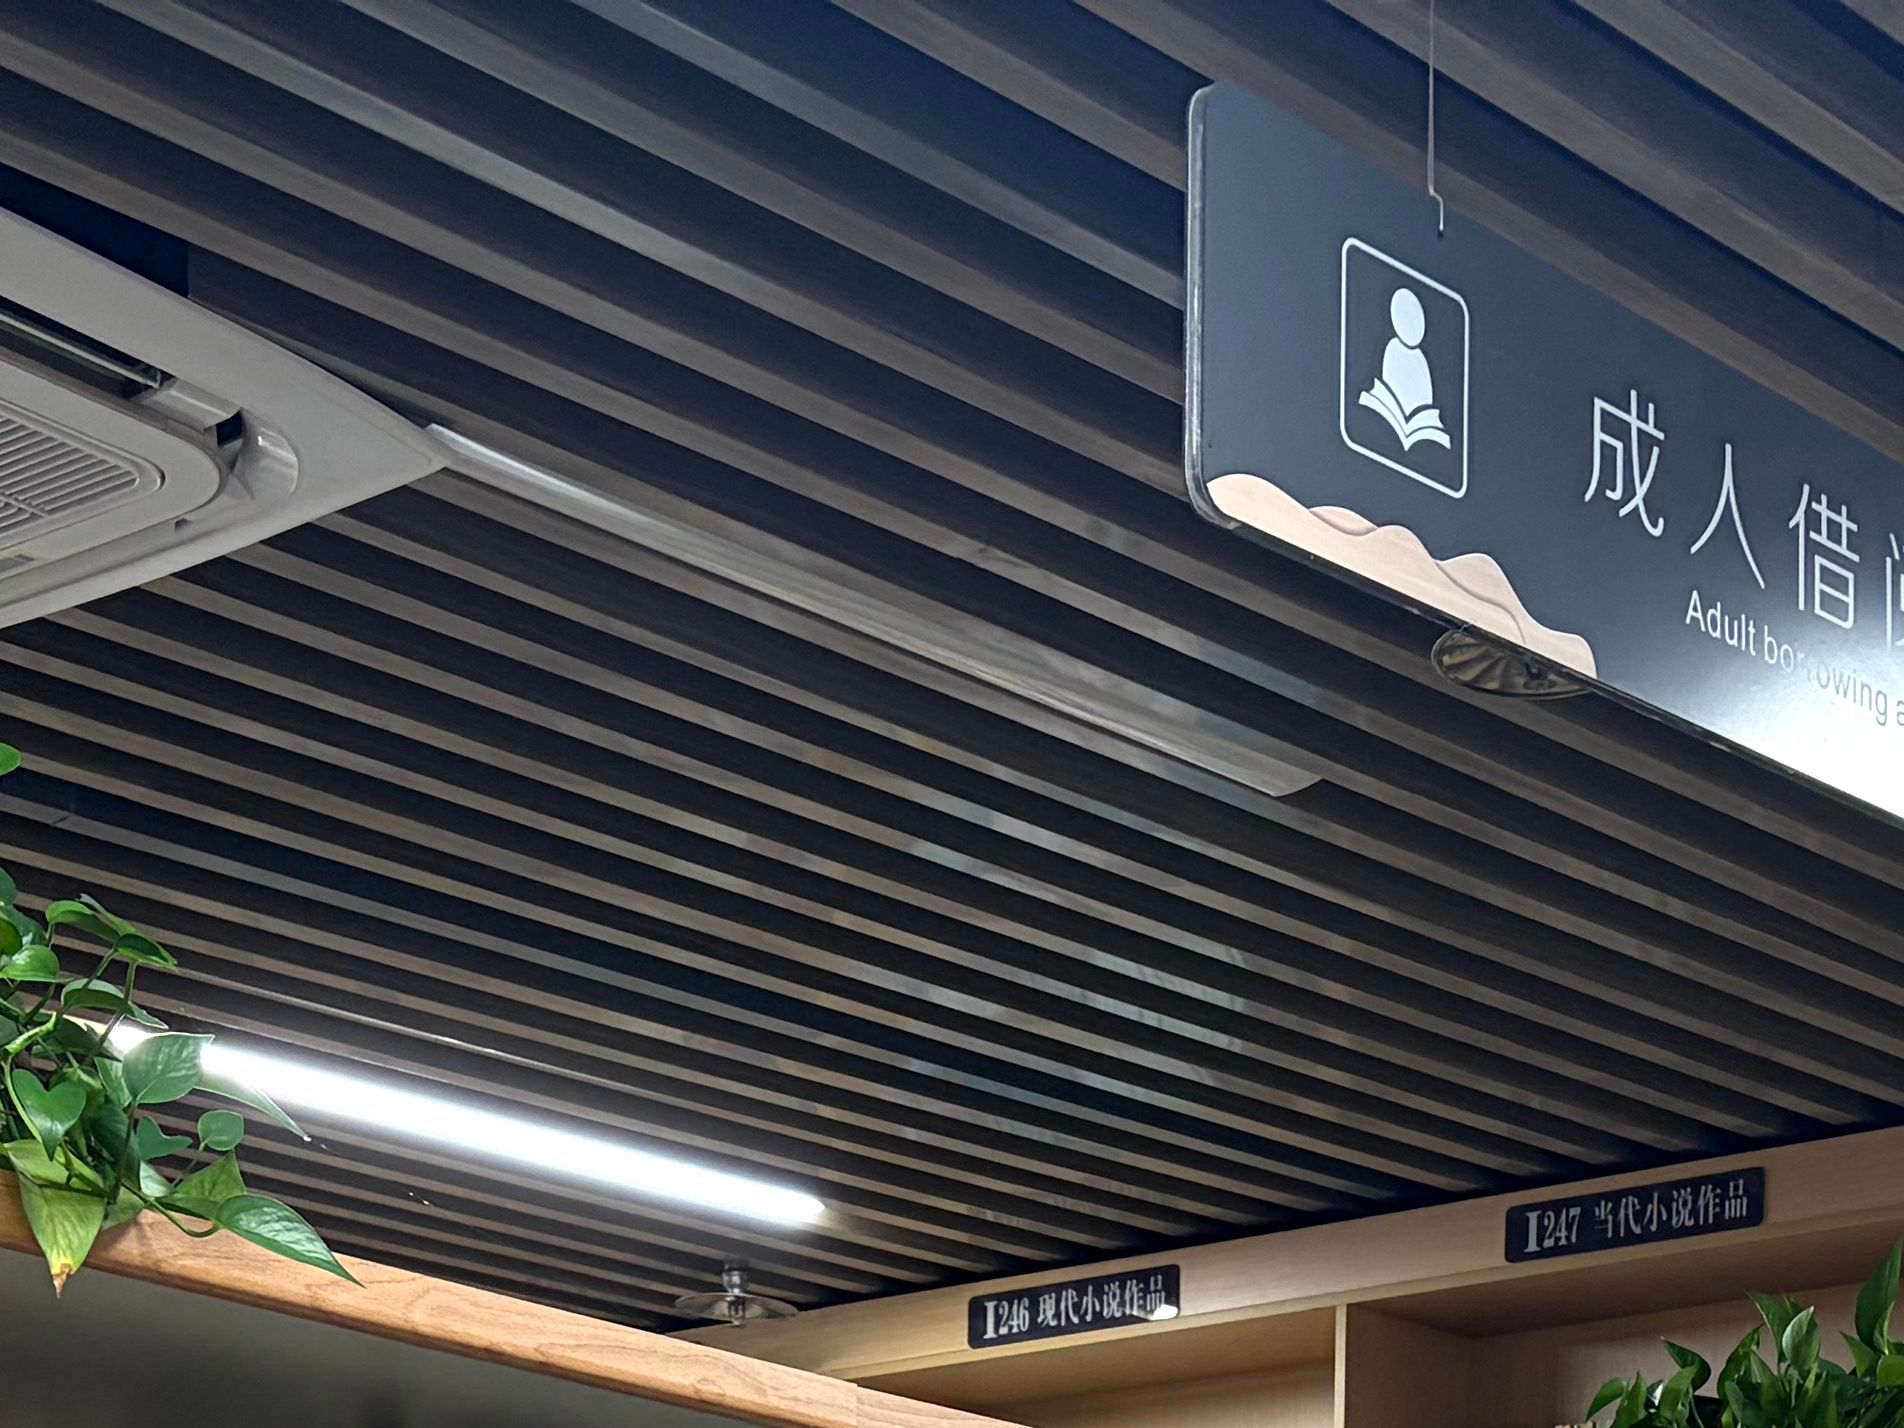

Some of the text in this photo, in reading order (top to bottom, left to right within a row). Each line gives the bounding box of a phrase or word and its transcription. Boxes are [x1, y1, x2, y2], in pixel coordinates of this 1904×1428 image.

[1685, 590, 1756, 656] Adult
[1523, 1176, 1749, 1253] I247 当代小说作品
[983, 1273, 1166, 1340] I246 现代小说作品
